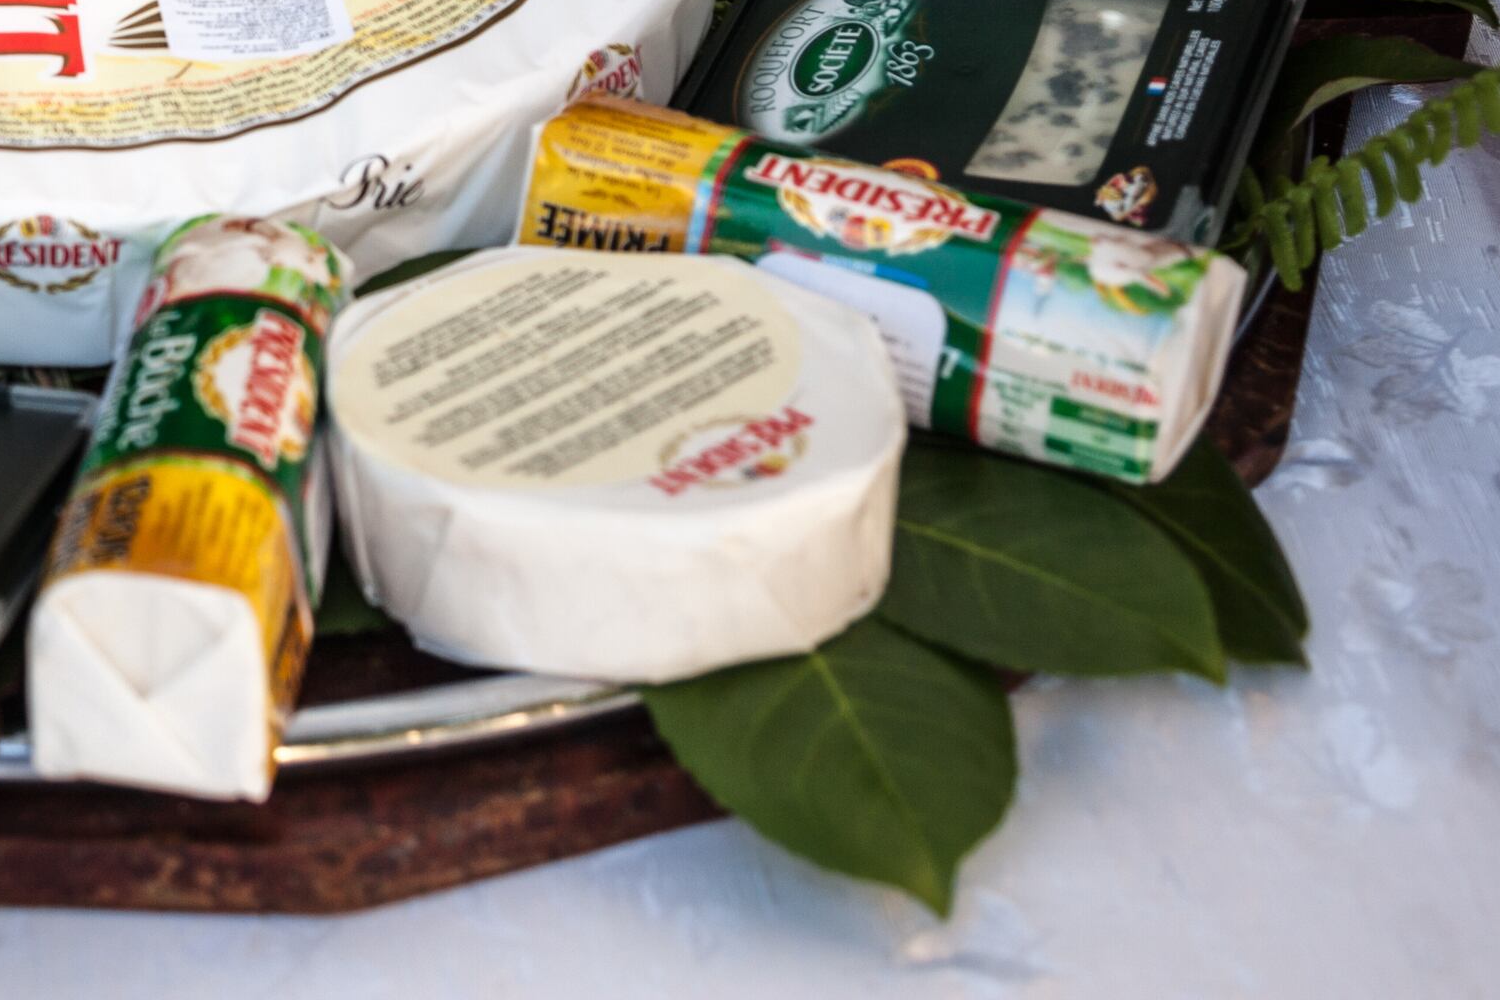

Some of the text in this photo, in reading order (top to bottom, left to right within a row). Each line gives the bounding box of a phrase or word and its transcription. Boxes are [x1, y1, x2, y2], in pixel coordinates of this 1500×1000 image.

[750, 4, 826, 114] ROQUEFORT
[809, 25, 863, 93] SOCIÉTÉ
[886, 41, 935, 86] 1863
[327, 154, 424, 212] Brie
[743, 153, 1000, 242] PRÉSIDENT
[648, 406, 815, 496] PRÉSIDENT
